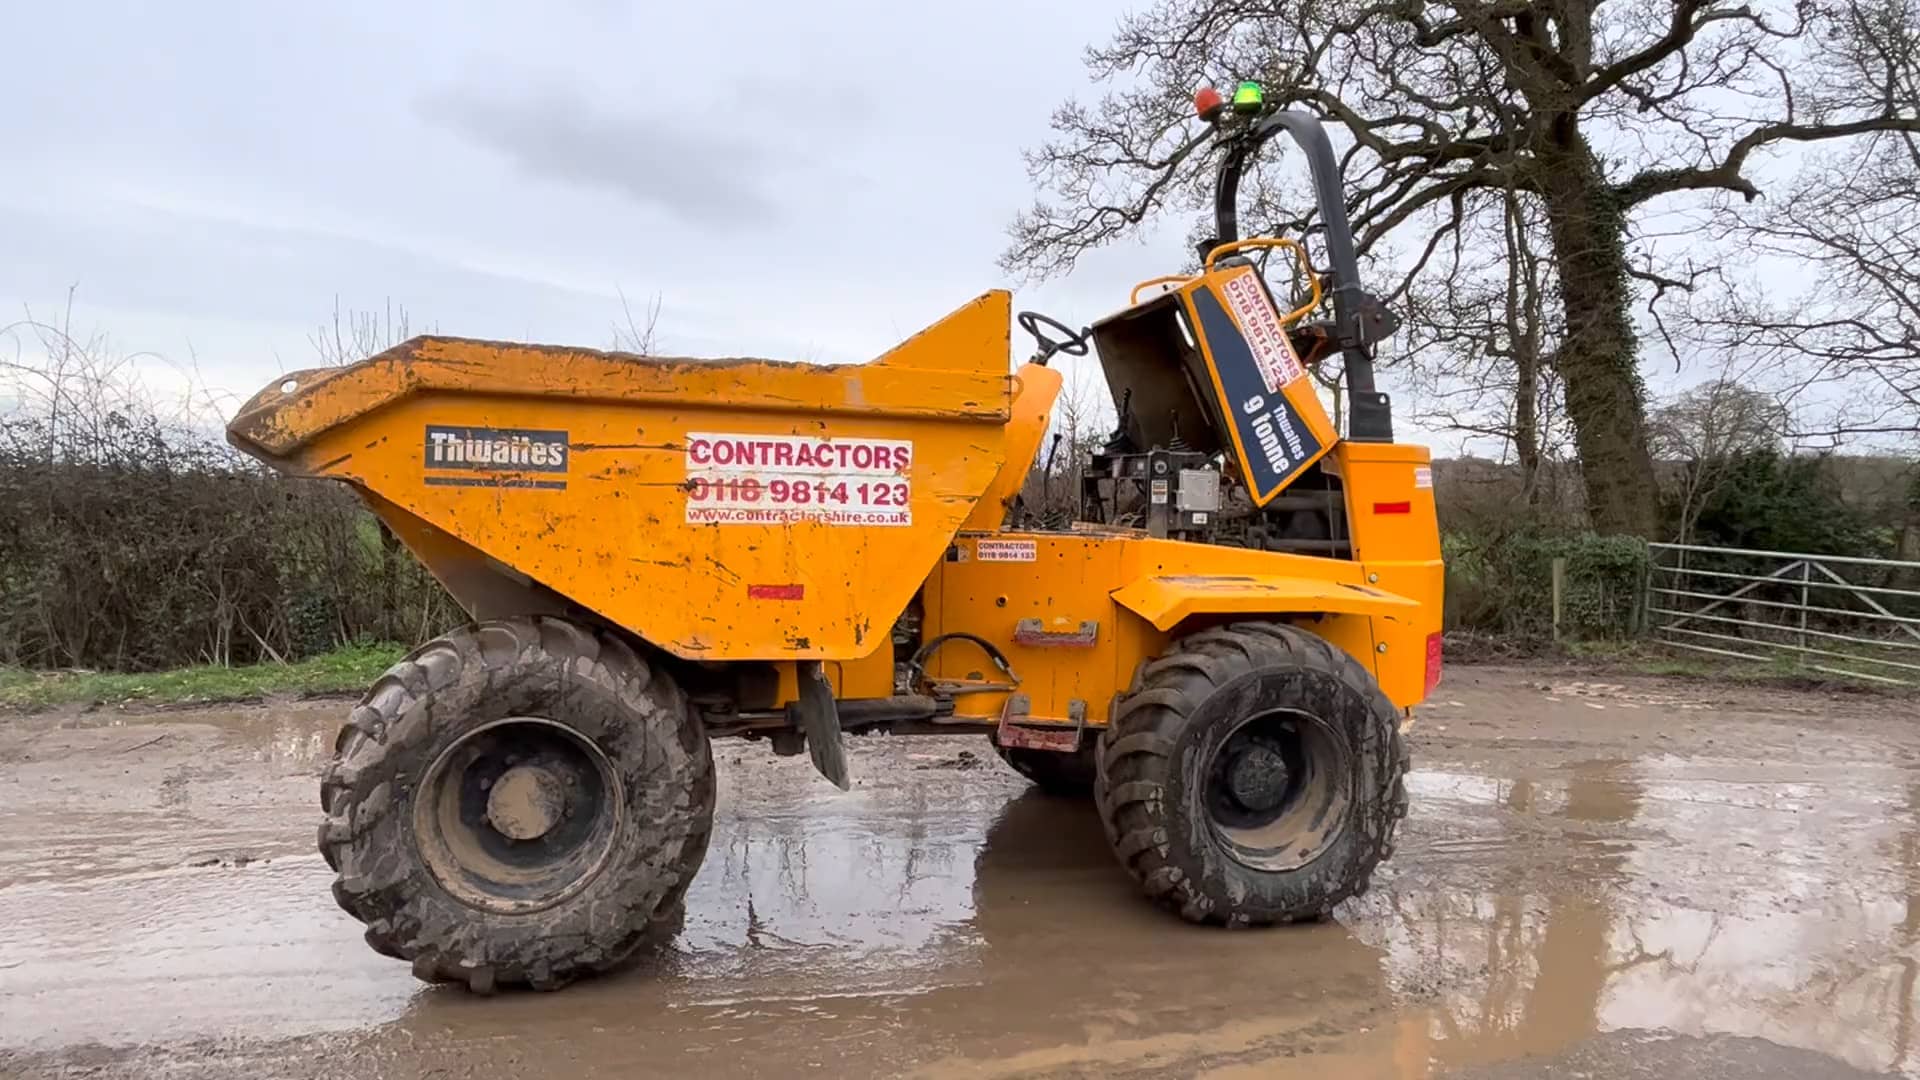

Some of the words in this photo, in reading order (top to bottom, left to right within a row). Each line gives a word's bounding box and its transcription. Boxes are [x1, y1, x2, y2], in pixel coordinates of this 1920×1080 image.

[1229, 281, 1252, 315] 0118
[1248, 317, 1272, 356] 9814
[1269, 359, 1288, 387] 123
[1243, 274, 1299, 378] CONTRACTORS
[1243, 395, 1265, 414] 9
[1251, 412, 1290, 474] tonne
[1273, 403, 1305, 460] Thwaites
[431, 432, 563, 466] Thwaites
[689, 439, 909, 470] CONTRACTORS
[688, 477, 761, 502] 0118
[770, 479, 849, 504] 9814
[857, 482, 909, 506] 123
[688, 509, 909, 524] www.contractorshire.co.uk
[978, 542, 1035, 550] CONTRACTORS
